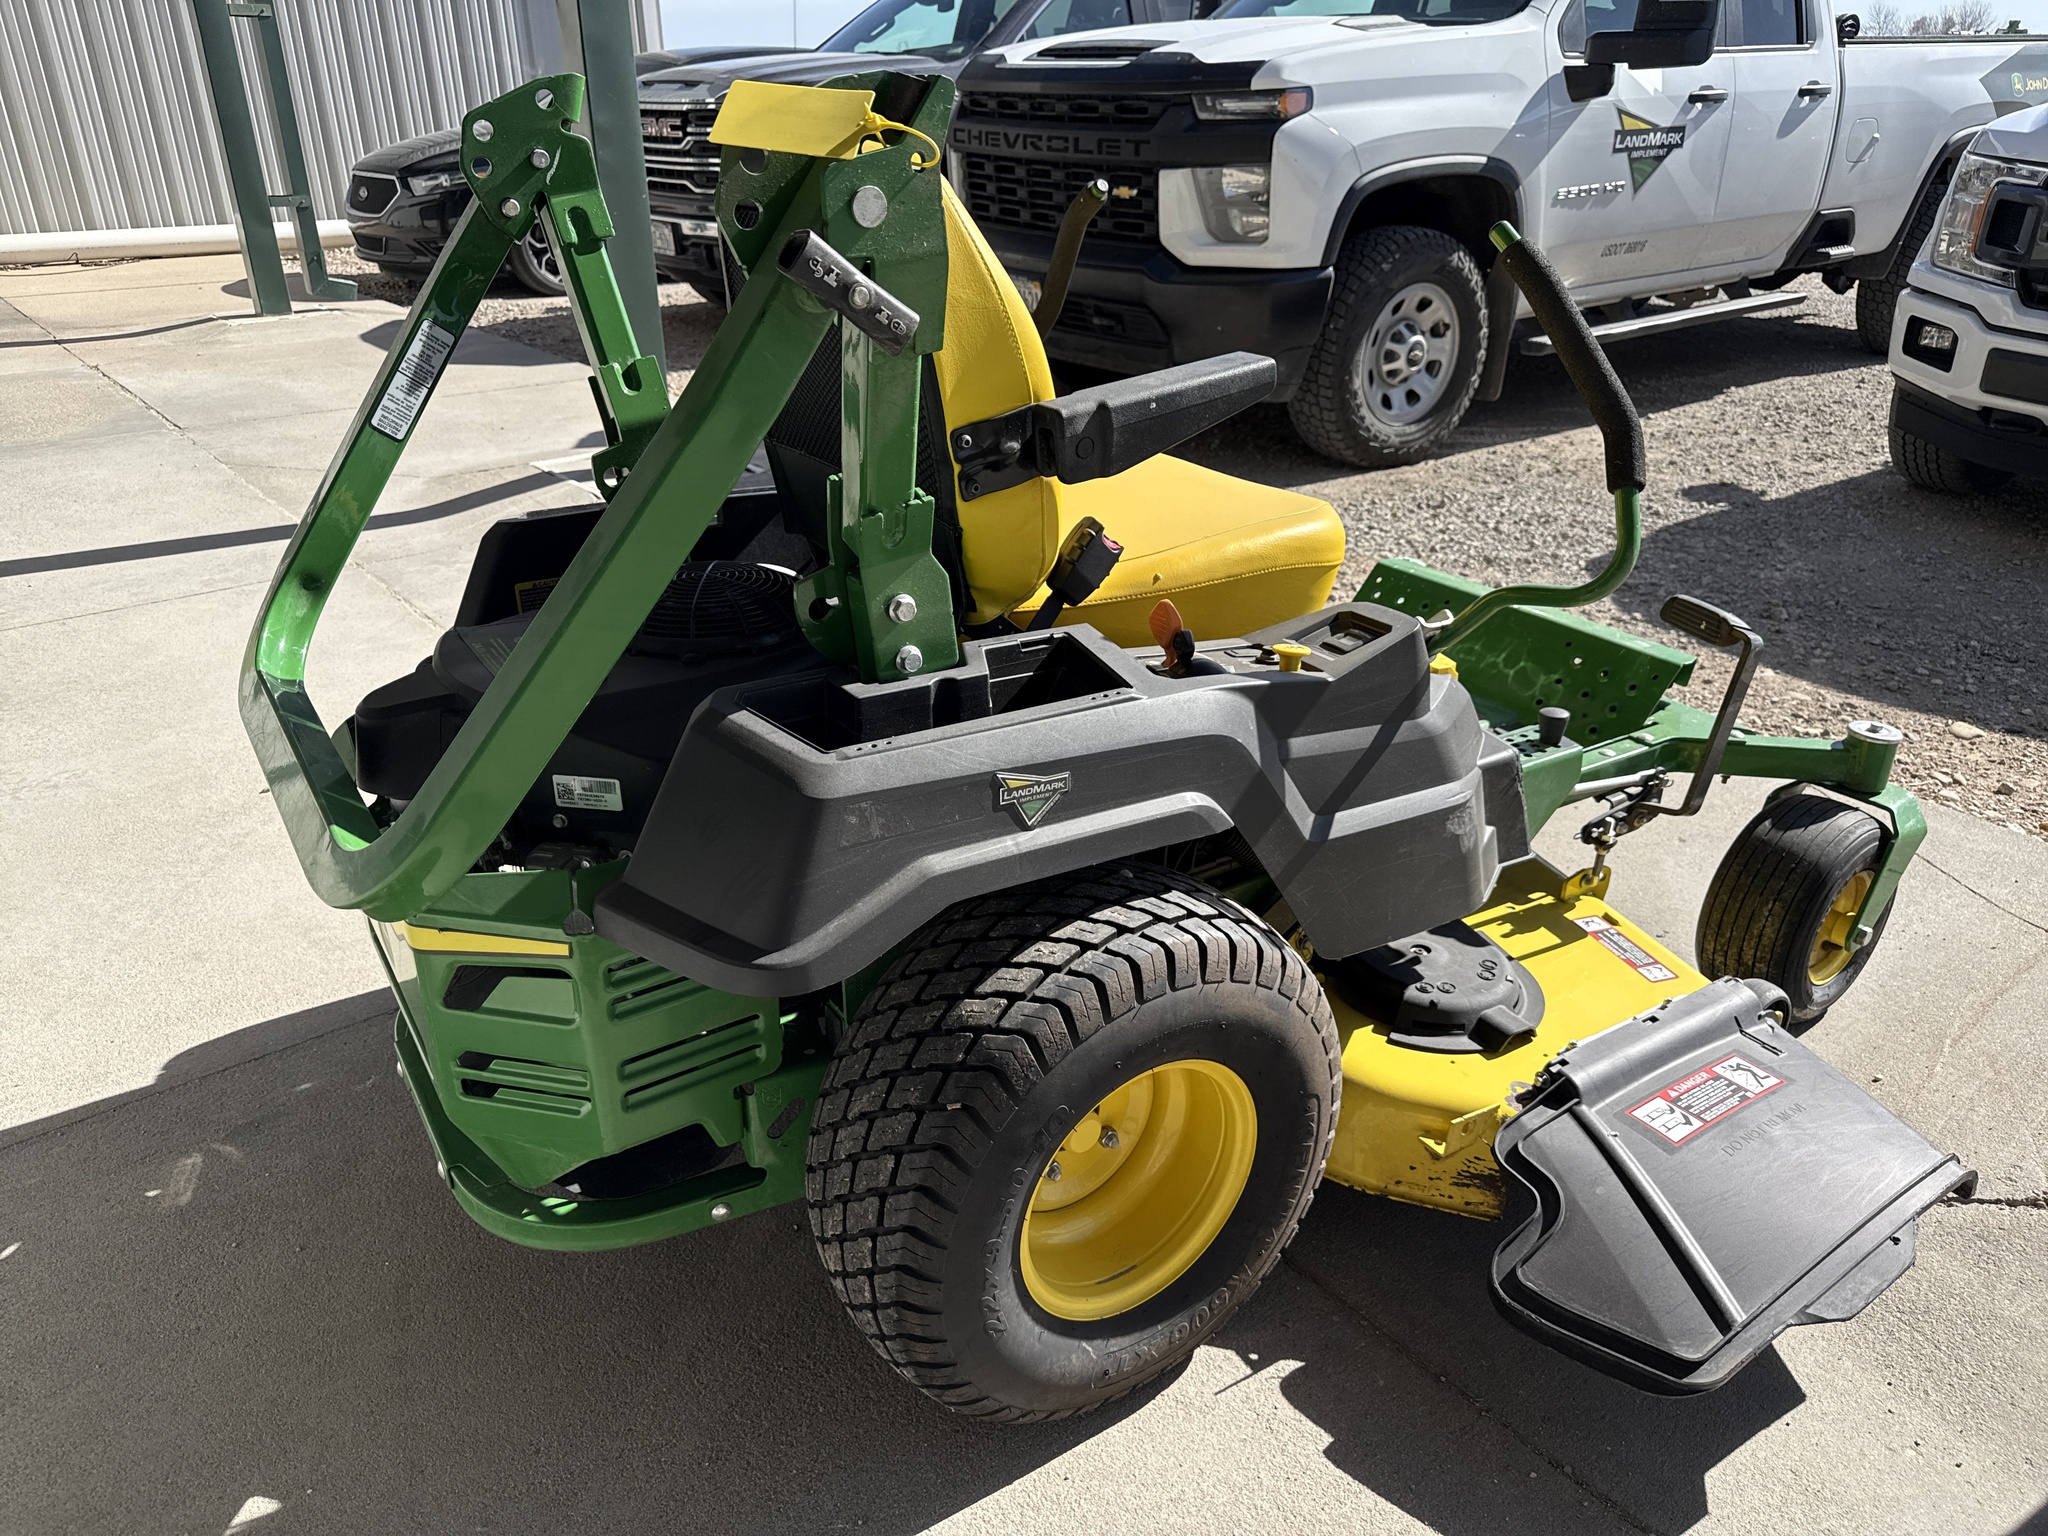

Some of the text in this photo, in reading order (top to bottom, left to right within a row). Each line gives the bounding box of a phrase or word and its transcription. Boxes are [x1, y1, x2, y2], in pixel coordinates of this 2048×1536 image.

[953, 127, 1151, 157] CHEVROLET
[1630, 148, 1668, 159] IMPLEMENT
[1019, 791, 1053, 803] IMPLEMENT
[1675, 1071, 1711, 1093] DANGER
[1721, 1140, 1743, 1157] DO
[1739, 1125, 1767, 1144] NOT
